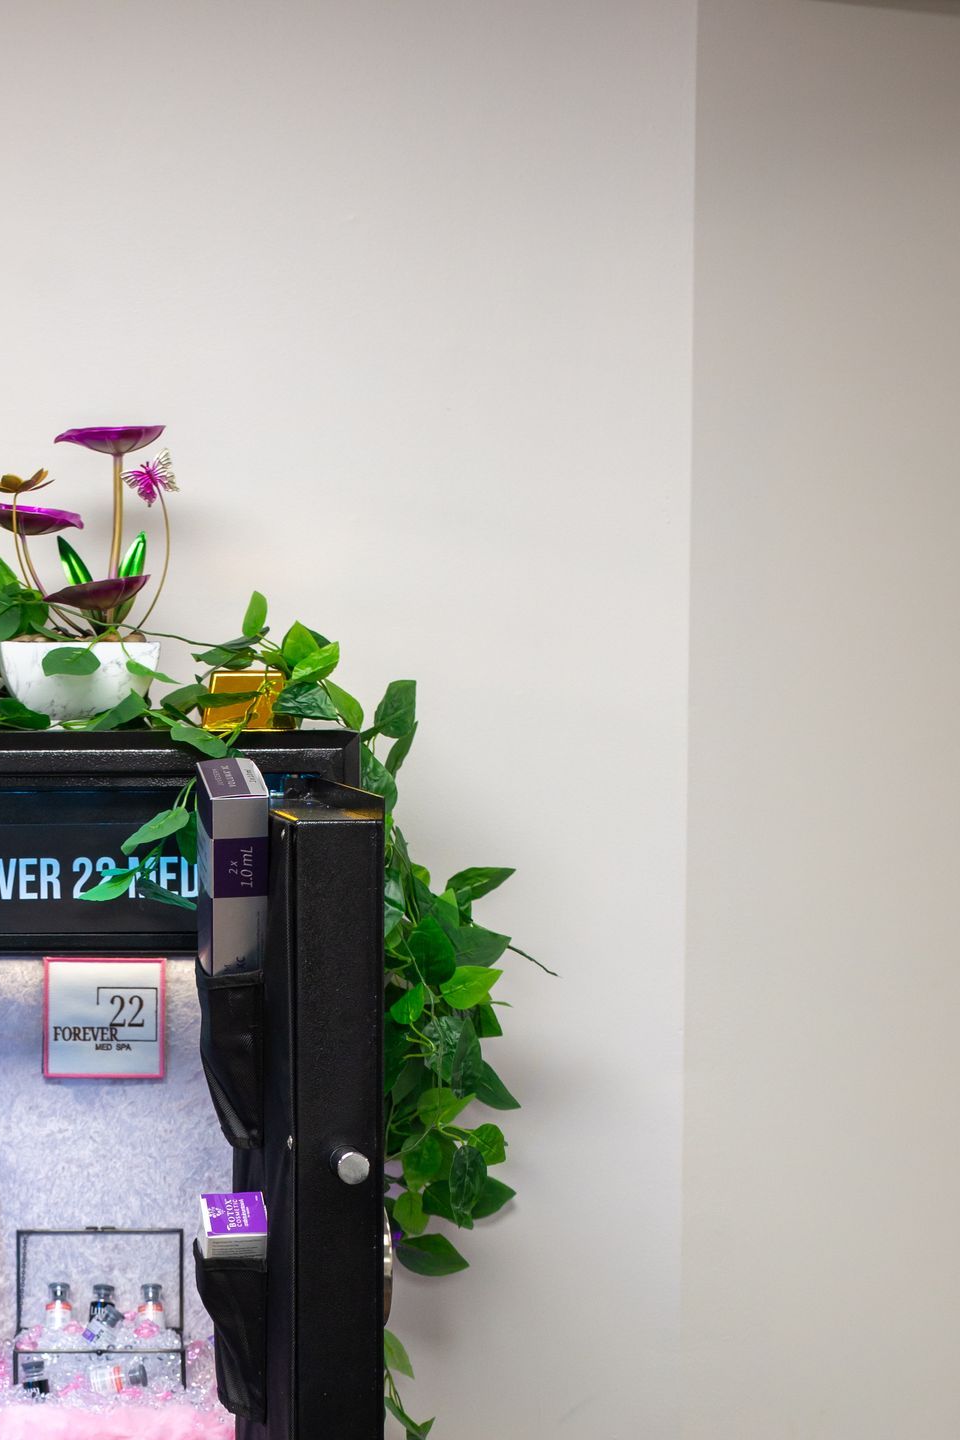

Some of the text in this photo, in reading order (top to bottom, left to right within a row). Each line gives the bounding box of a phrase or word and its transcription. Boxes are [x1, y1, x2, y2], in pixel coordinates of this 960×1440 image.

[109, 994, 145, 1028] 22
[53, 1026, 119, 1042] FOREVER
[95, 1043, 133, 1052] MED SPA
